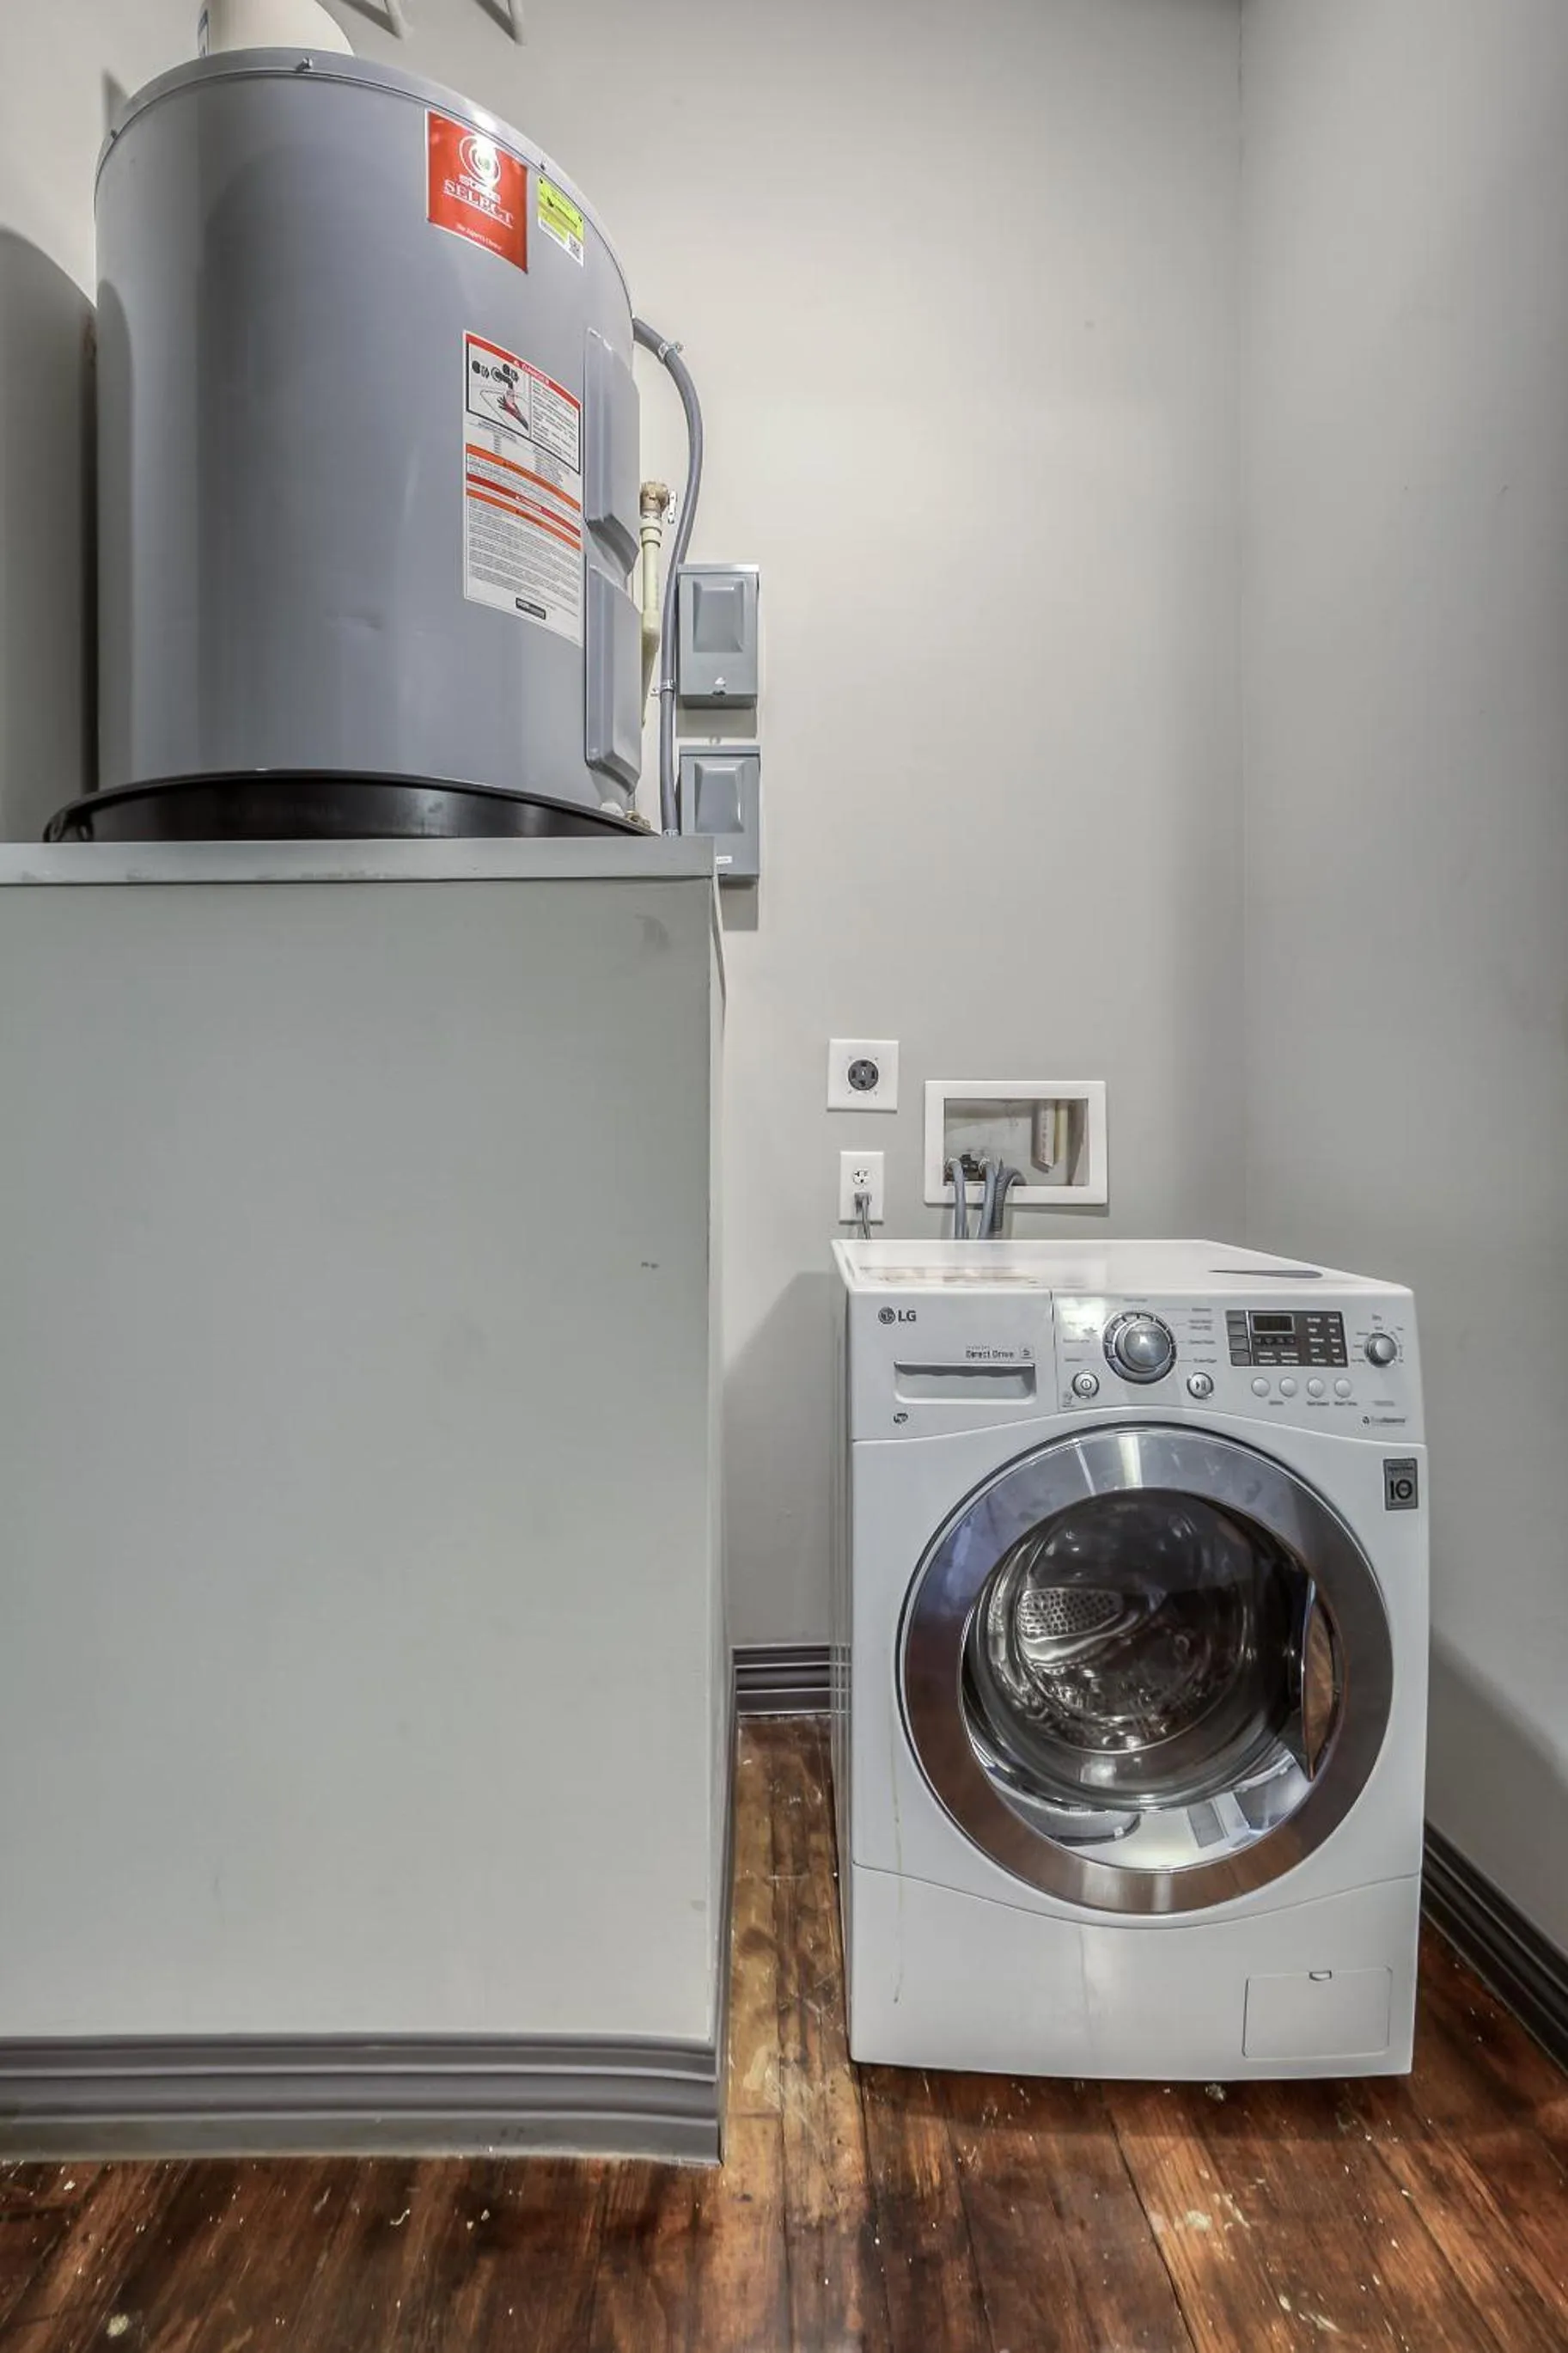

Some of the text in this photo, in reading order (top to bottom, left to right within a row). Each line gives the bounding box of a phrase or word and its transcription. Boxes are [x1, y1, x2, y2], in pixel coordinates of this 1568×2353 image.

[443, 179, 514, 224] SELECT
[898, 1310, 917, 1322] LG
[1390, 1479, 1412, 1500] 10
